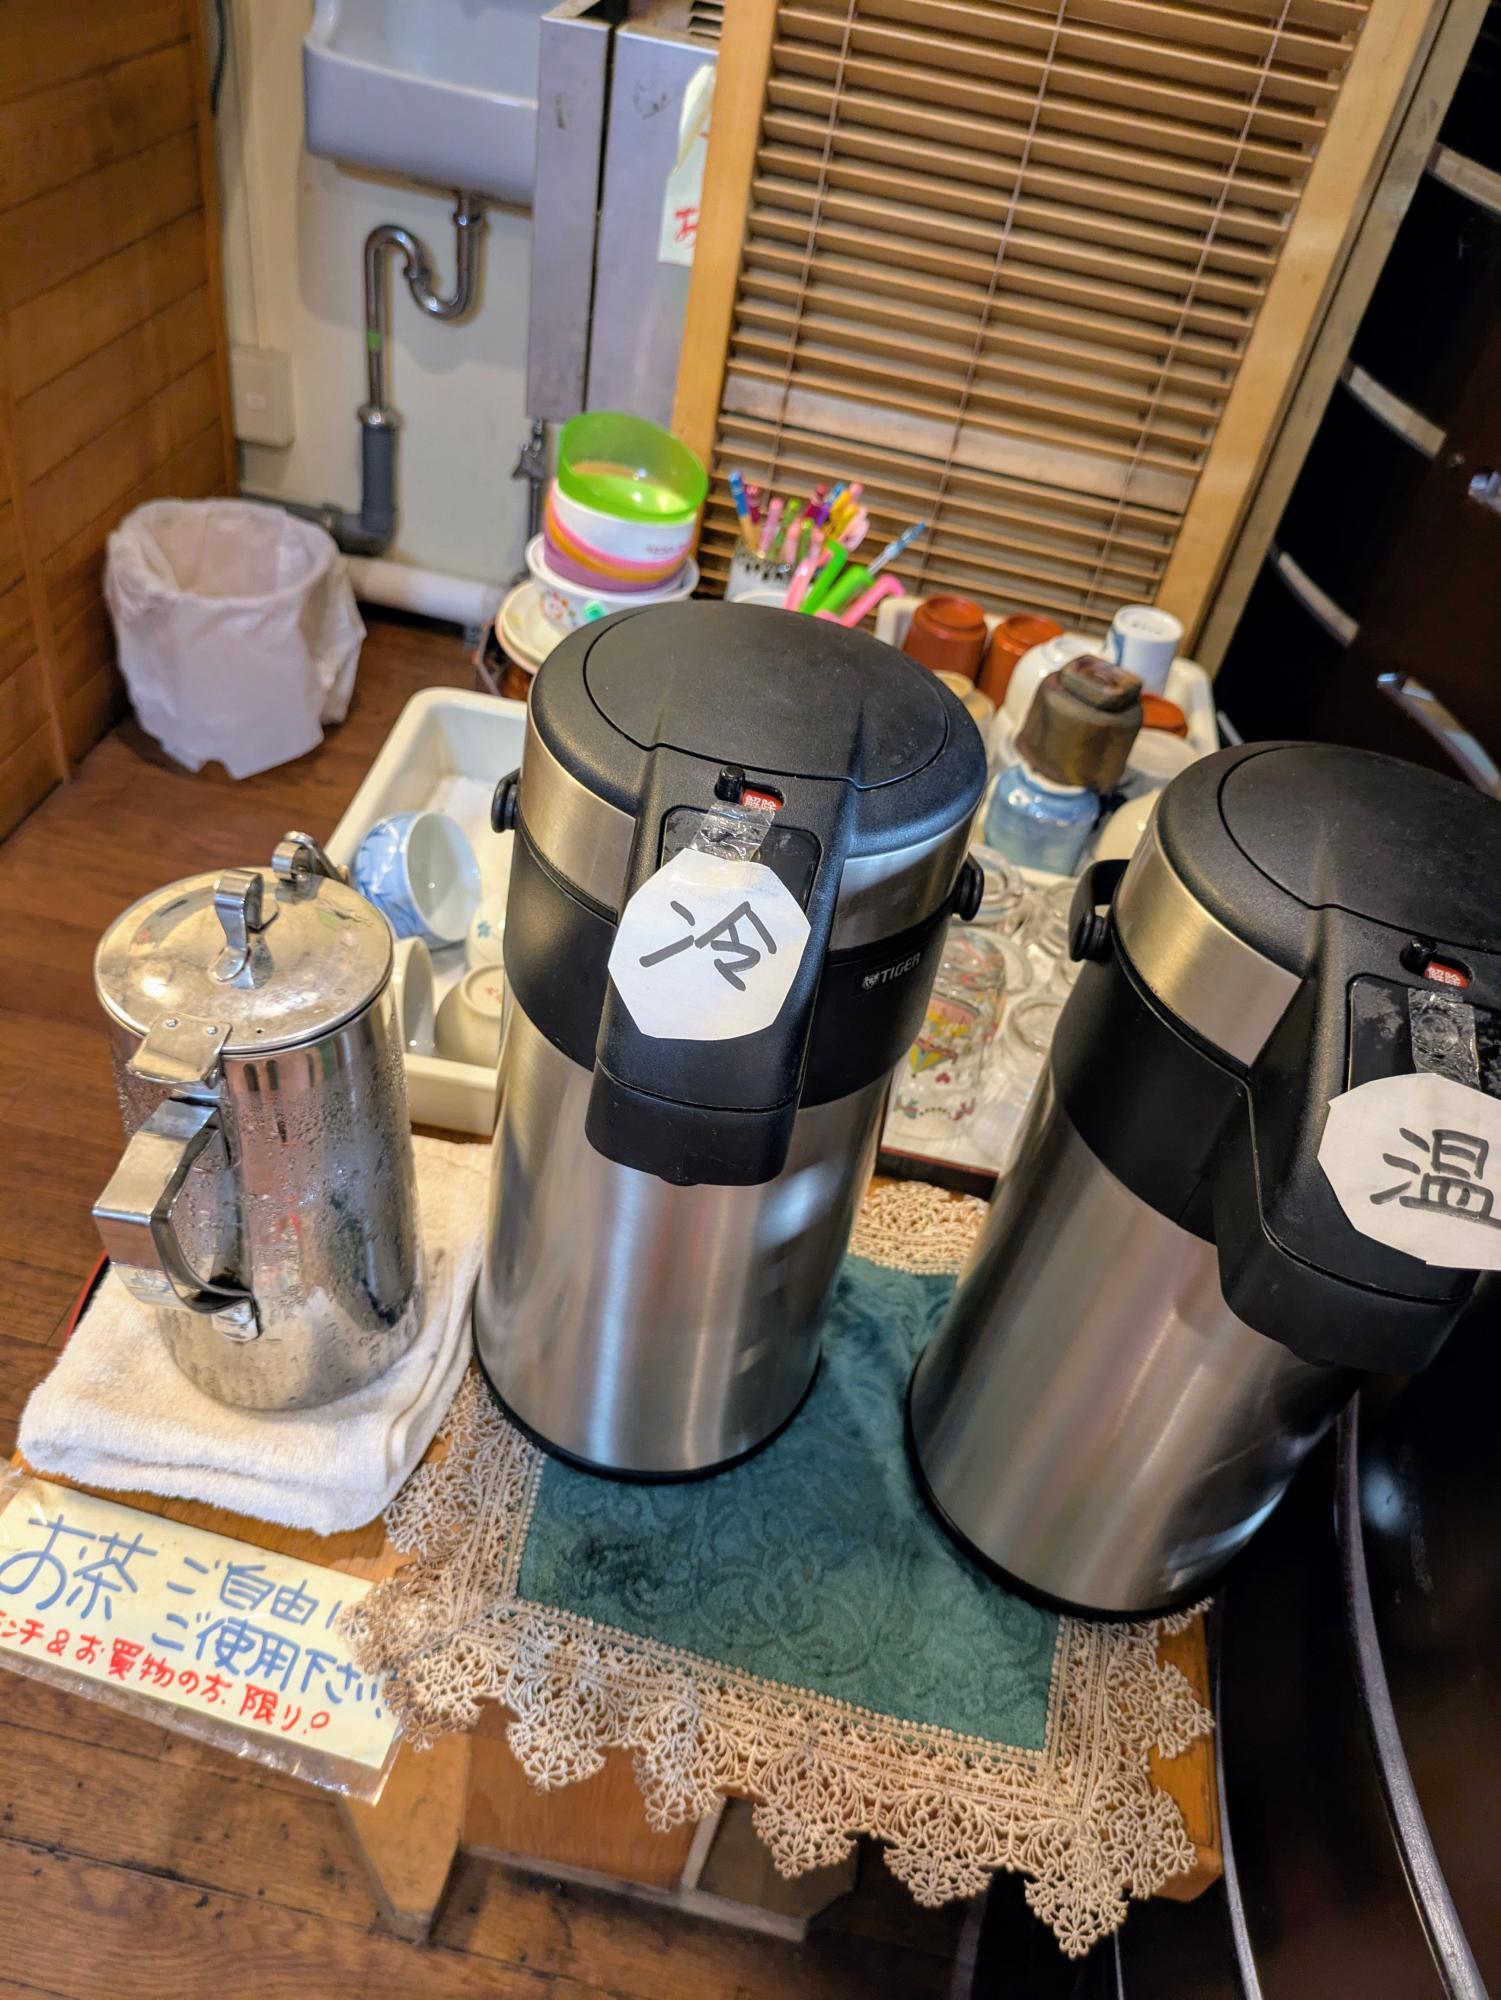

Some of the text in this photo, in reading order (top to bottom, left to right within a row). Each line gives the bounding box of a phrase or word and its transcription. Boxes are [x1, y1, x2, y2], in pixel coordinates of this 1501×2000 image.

[639, 900, 778, 992] 冷
[880, 952, 921, 983] TIGER
[1369, 1127, 1501, 1230] 温
[0, 1514, 158, 1620] お茶
